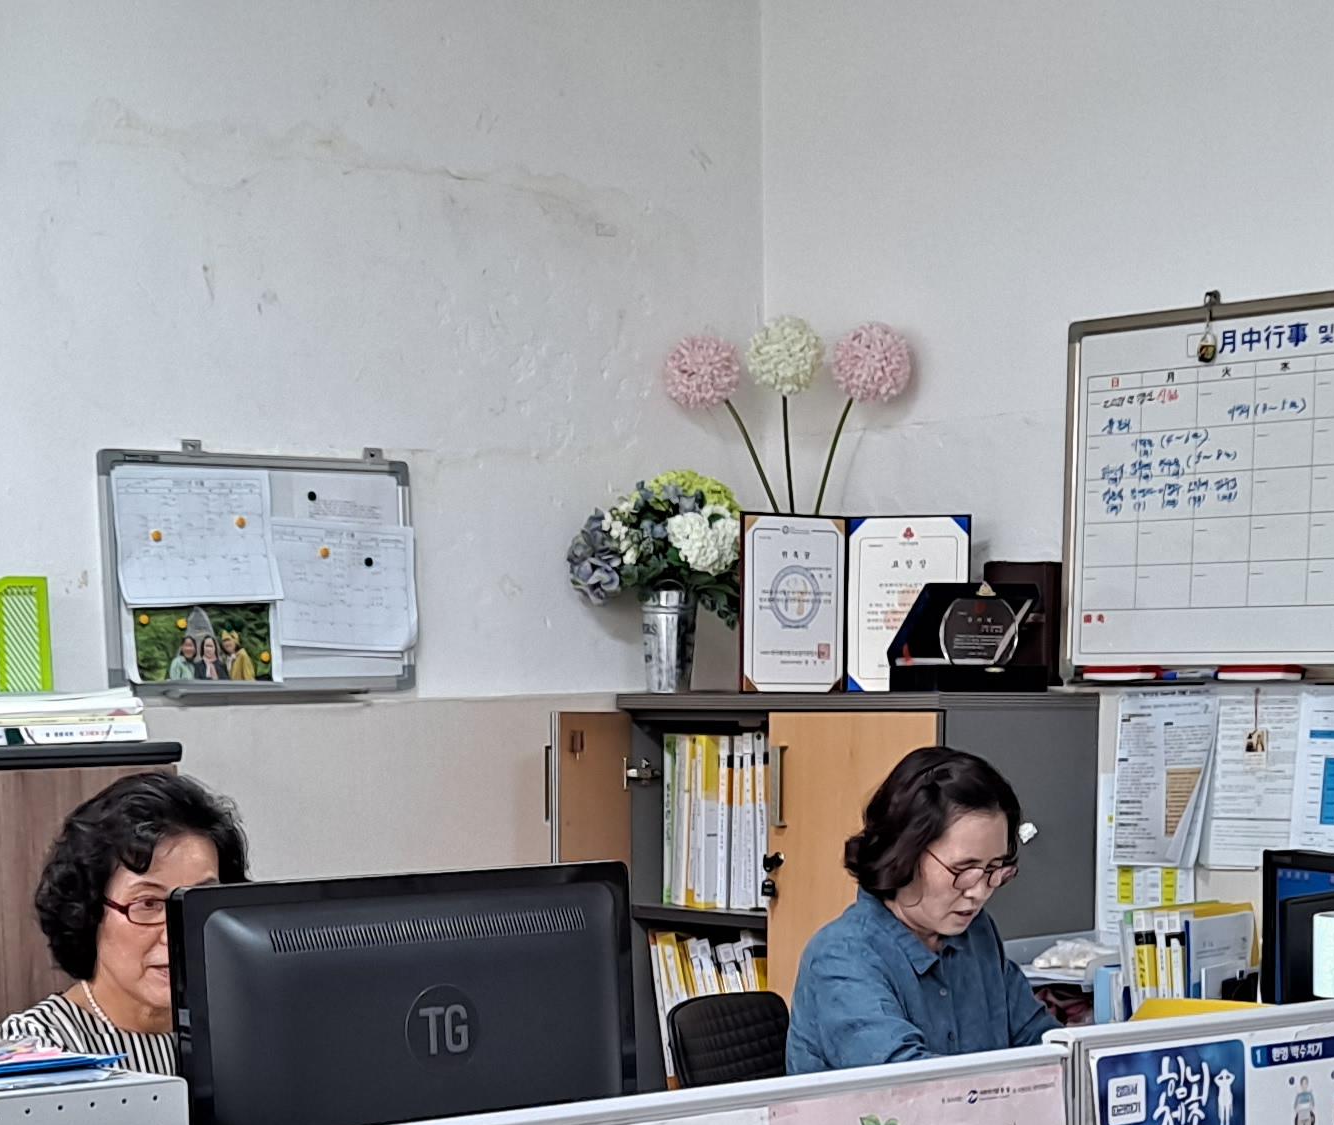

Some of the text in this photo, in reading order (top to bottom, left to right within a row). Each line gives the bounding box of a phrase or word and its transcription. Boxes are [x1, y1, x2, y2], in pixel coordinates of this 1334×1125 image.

[1219, 322, 1309, 353] 月中行事
[1318, 323, 1334, 344] 및
[419, 1004, 469, 1055] TG
[1255, 1049, 1262, 1064] 1
